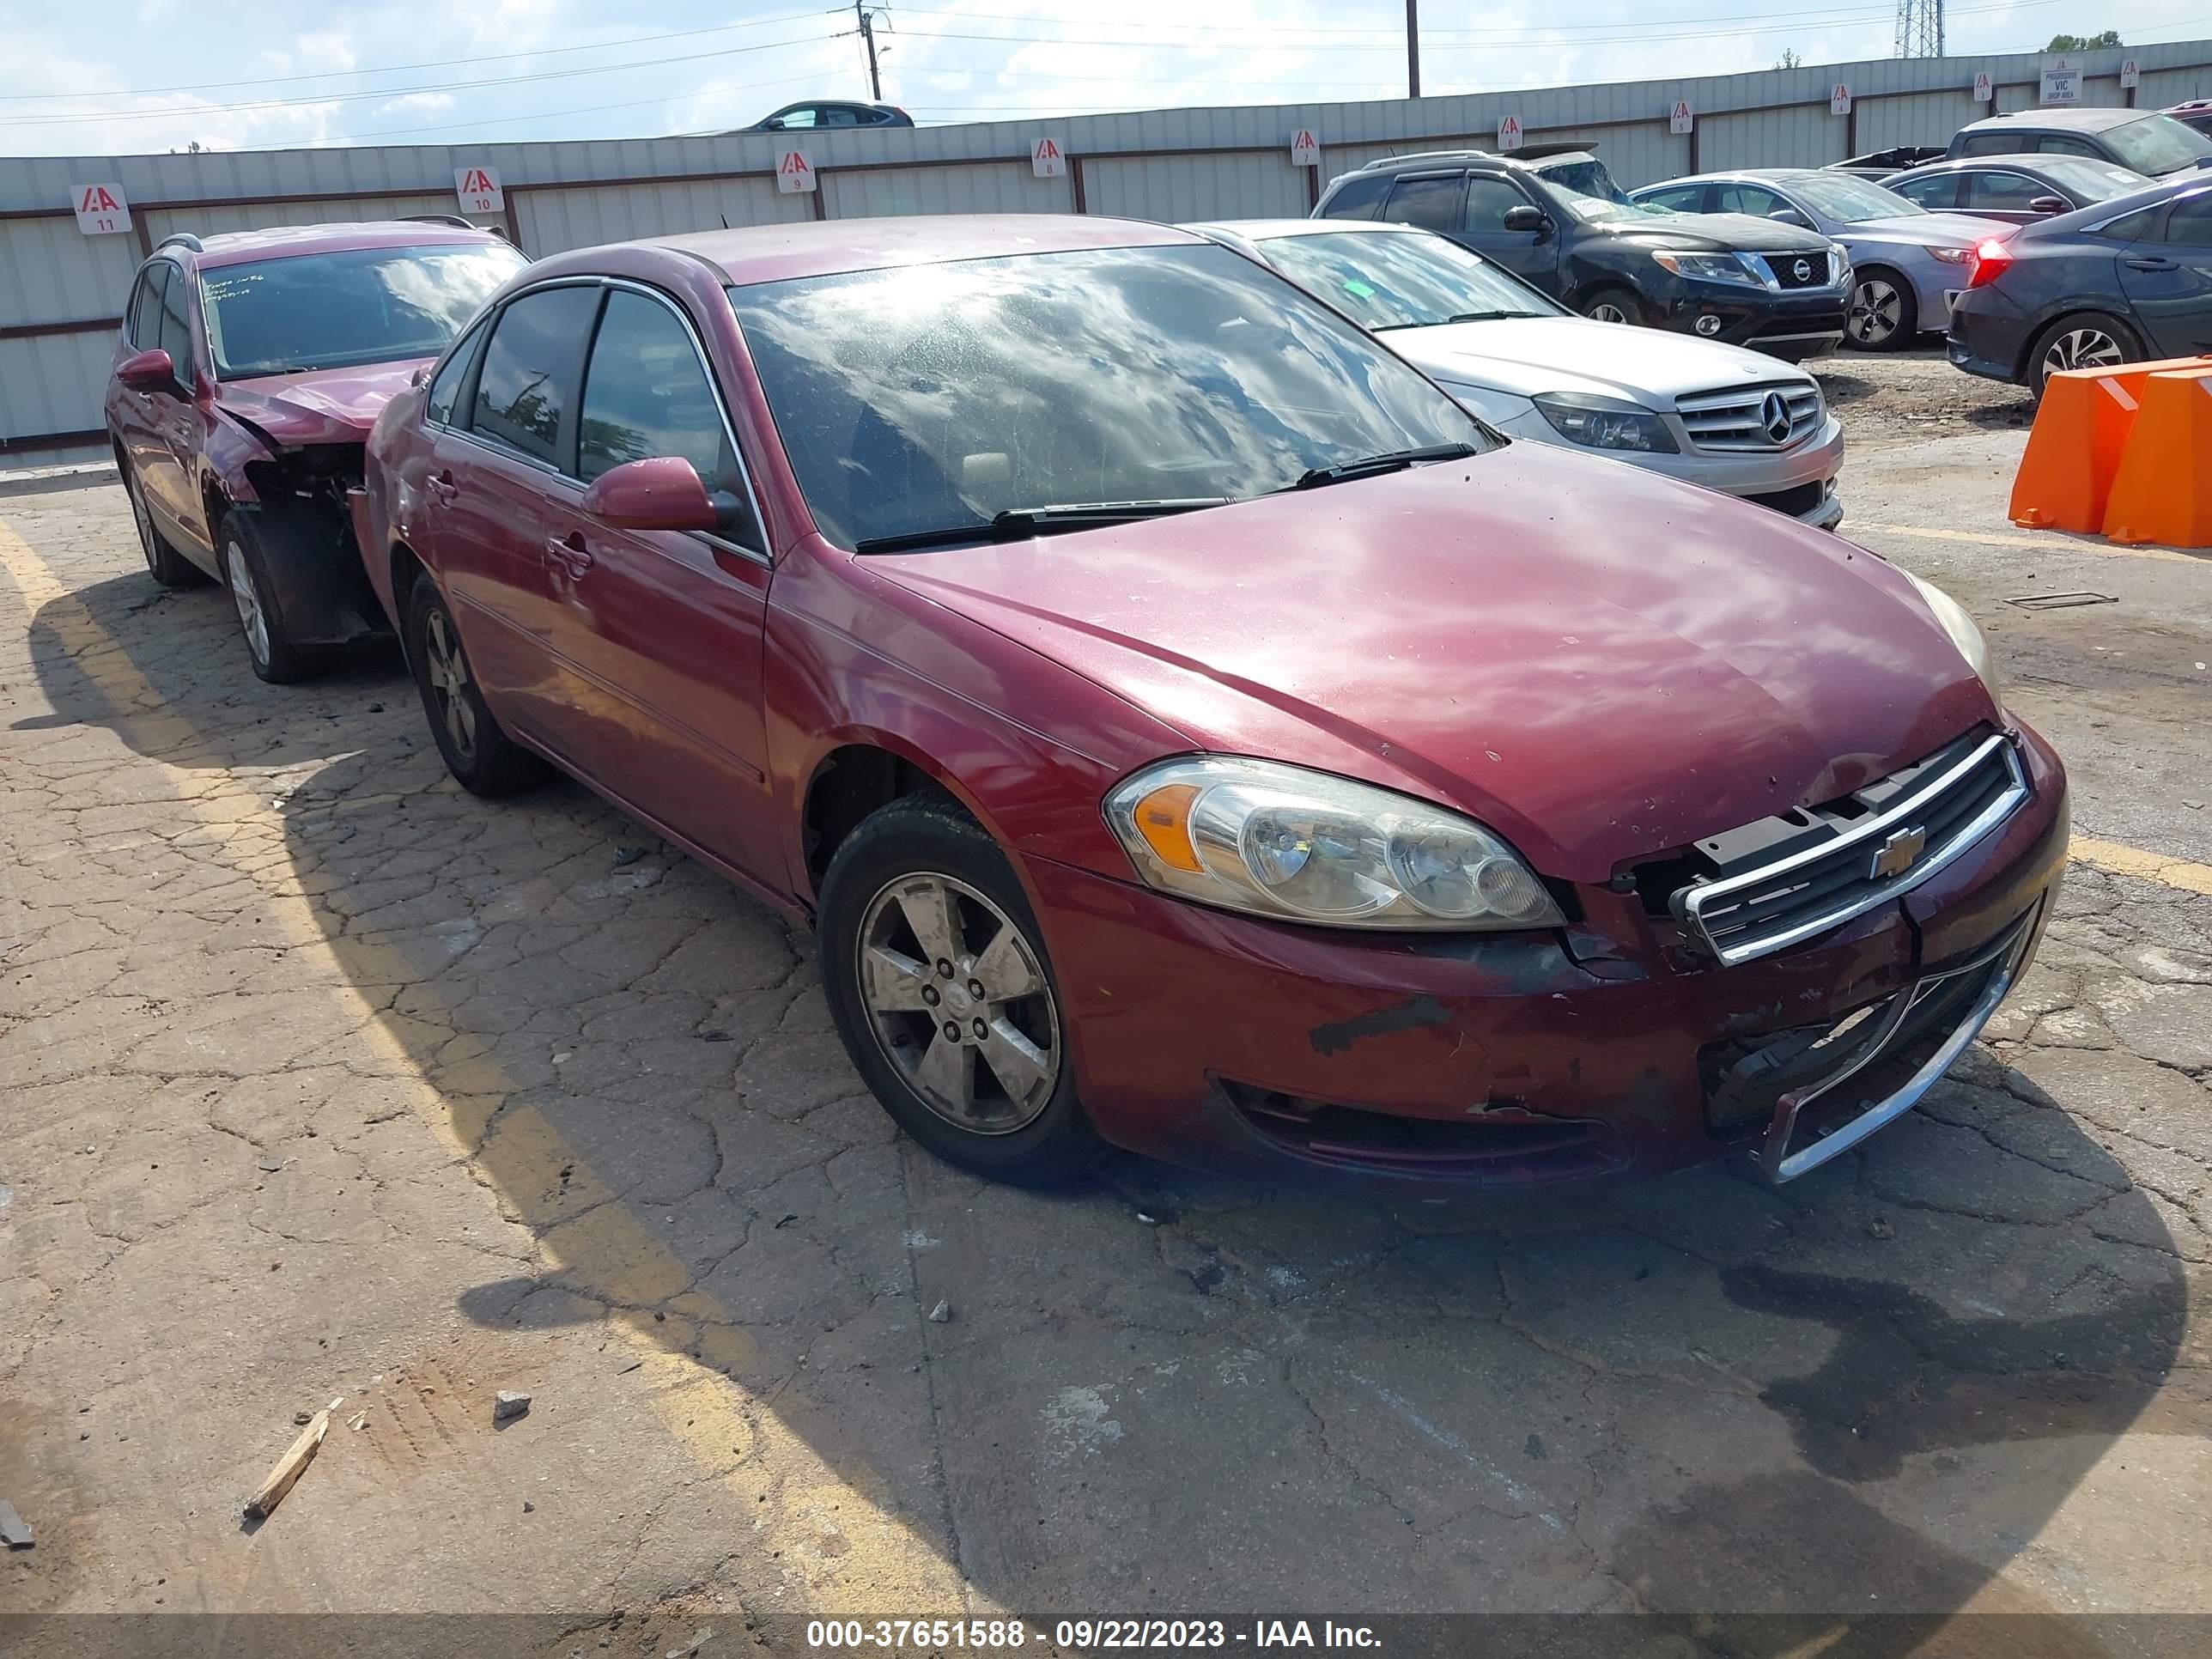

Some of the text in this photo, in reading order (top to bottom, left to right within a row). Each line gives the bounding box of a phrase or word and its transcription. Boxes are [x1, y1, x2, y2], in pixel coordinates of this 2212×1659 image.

[2055, 80, 2069, 91] VIC
[793, 179, 800, 190] 9
[474, 198, 489, 210] 10
[95, 218, 113, 232] 11
